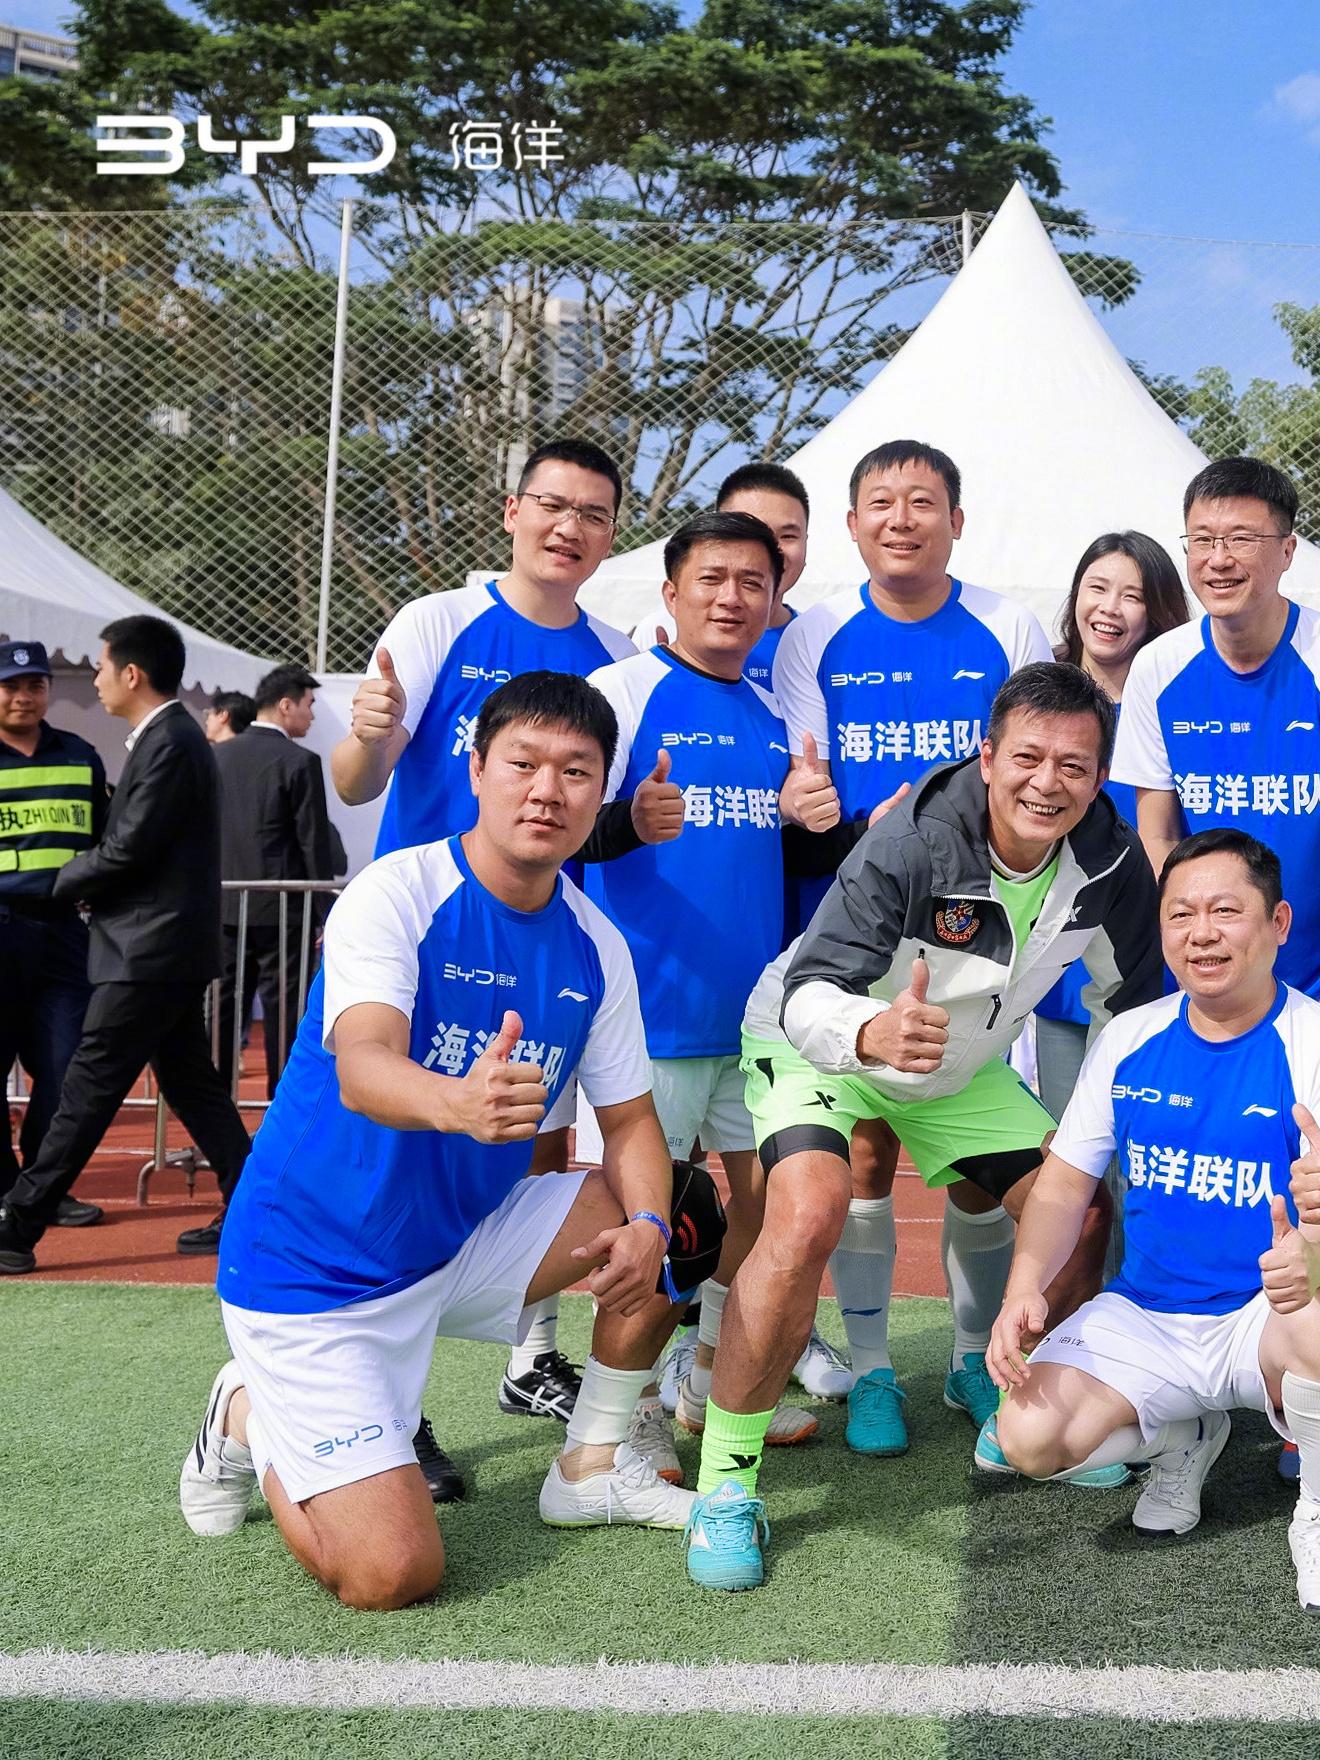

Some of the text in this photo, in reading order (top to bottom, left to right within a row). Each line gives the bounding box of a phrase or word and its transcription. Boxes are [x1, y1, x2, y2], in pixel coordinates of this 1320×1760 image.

[461, 665, 512, 682] BYD
[831, 671, 913, 686] BYD 海洋
[661, 732, 713, 746] BYD
[1173, 721, 1251, 734] BYD 海洋
[836, 719, 983, 763] 海洋联队
[680, 784, 783, 829] 海洋联
[444, 962, 495, 985] BYD
[1111, 1084, 1194, 1108] BYD 海洋
[313, 1424, 384, 1458] BYD
